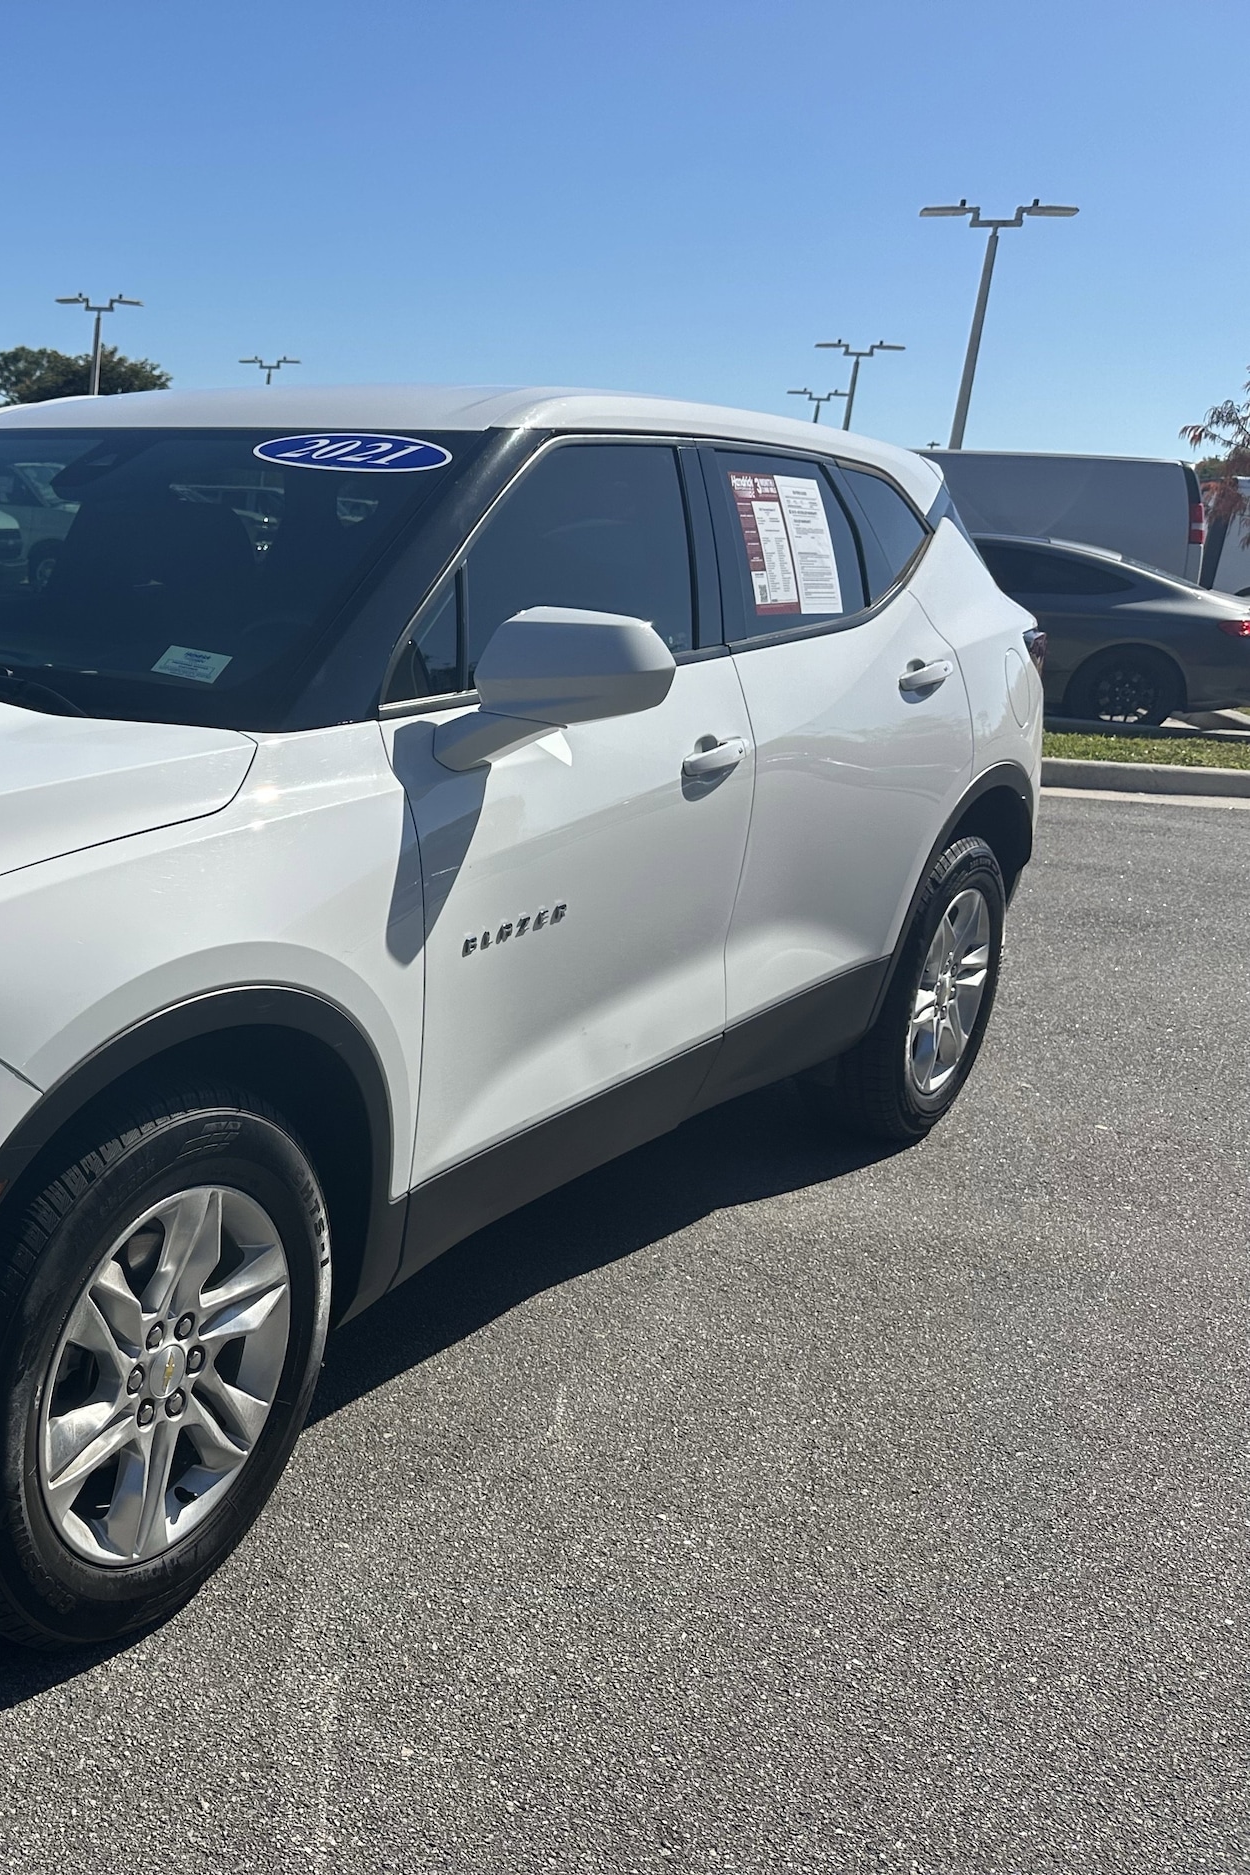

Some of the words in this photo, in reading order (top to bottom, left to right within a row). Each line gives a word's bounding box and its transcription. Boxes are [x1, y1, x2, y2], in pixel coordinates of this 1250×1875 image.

[276, 439, 426, 465] 2021
[754, 477, 762, 494] 3
[461, 903, 567, 958] BLAZER
